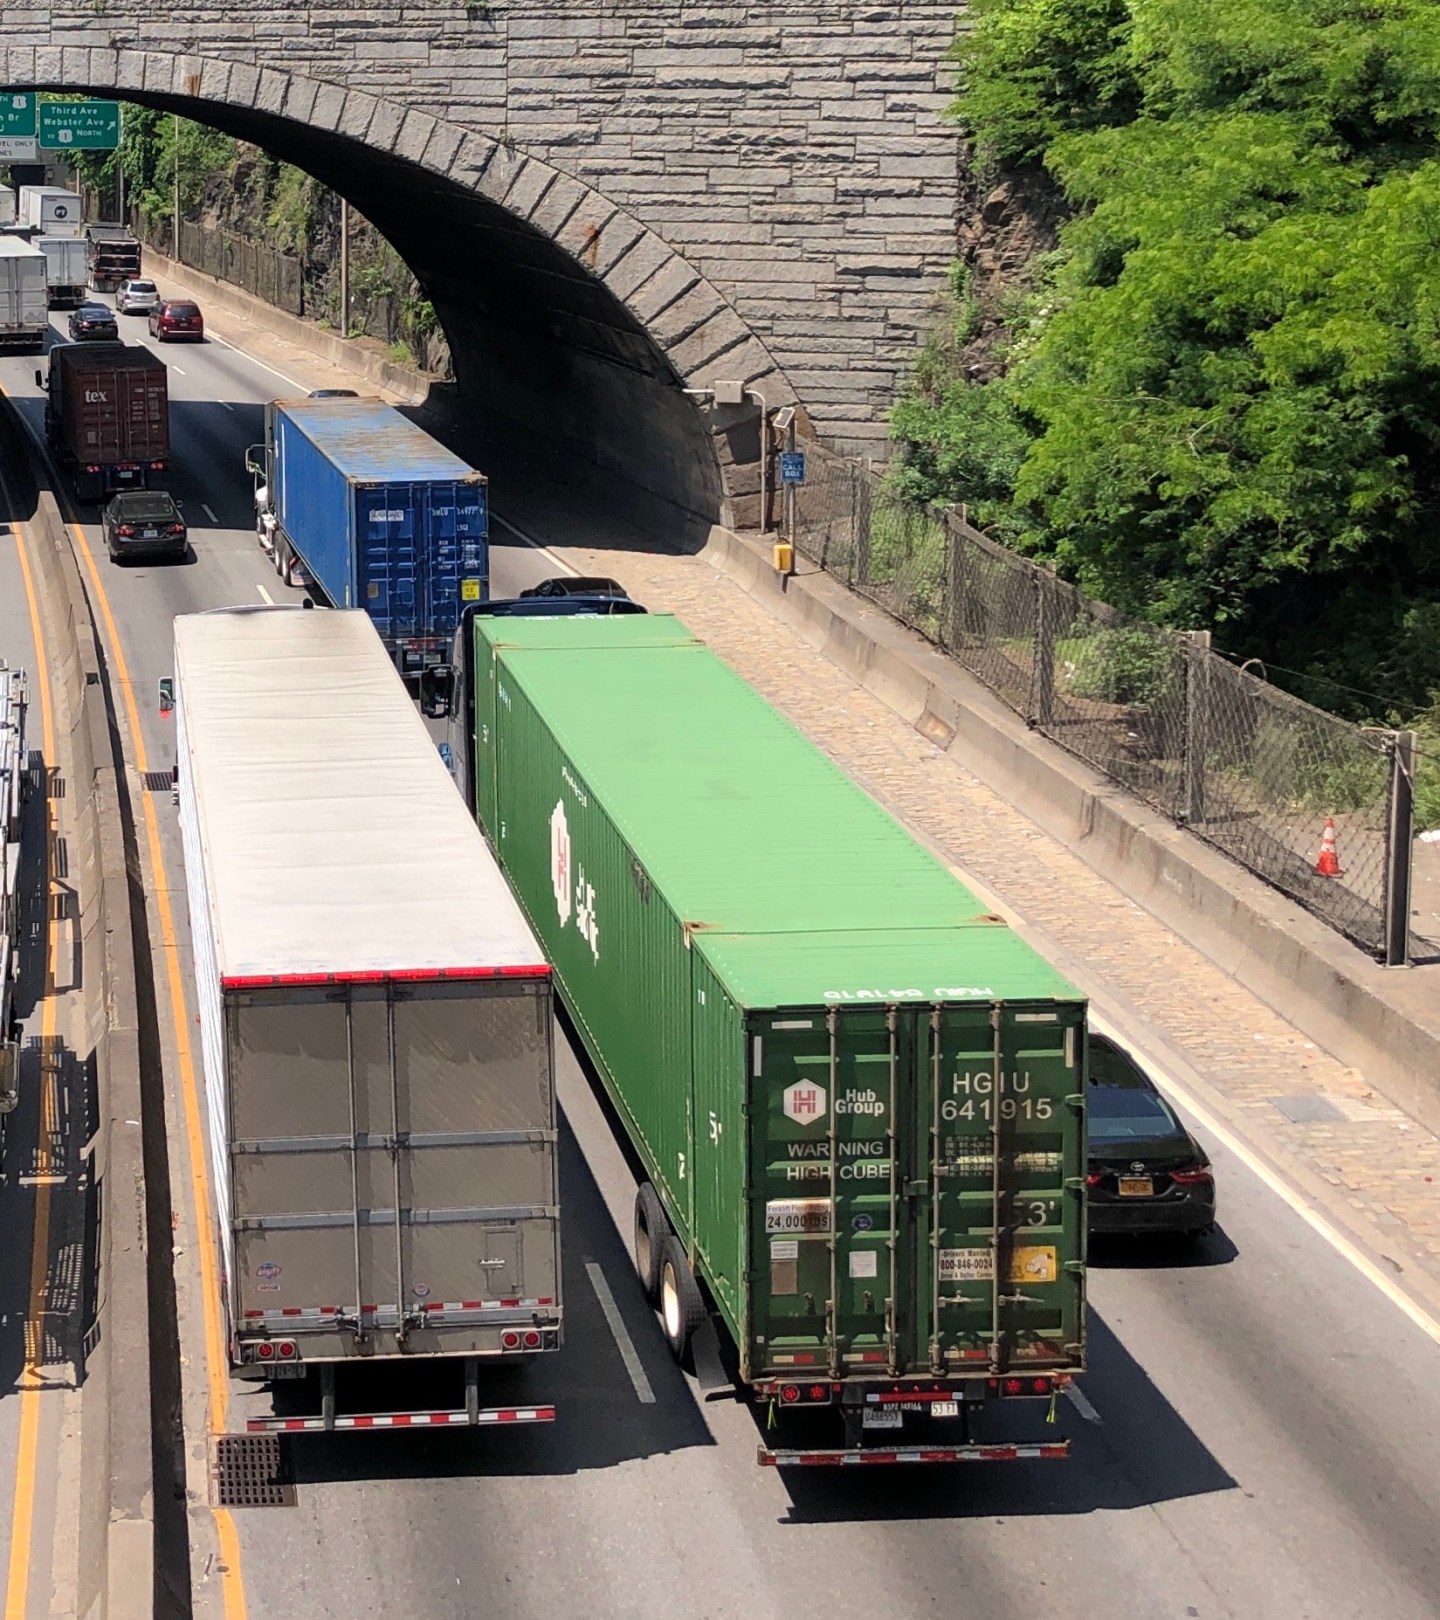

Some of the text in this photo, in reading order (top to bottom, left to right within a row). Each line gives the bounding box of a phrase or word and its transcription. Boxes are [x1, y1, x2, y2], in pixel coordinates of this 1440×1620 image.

[8, 113, 20, 121] Br
[51, 106, 98, 115] Third Ave
[43, 118, 104, 126] Webster Ave
[85, 389, 108, 403] tex
[952, 1071, 1030, 1094] HGIU
[845, 1088, 876, 1102] Hub
[834, 1098, 885, 1117] Group
[941, 1097, 1052, 1121] 641915
[786, 1141, 884, 1158] WARNING
[786, 1164, 890, 1181] HIGH CUBE
[767, 1214, 807, 1230] 24,000
[932, 1402, 956, 1414] 53 FT
